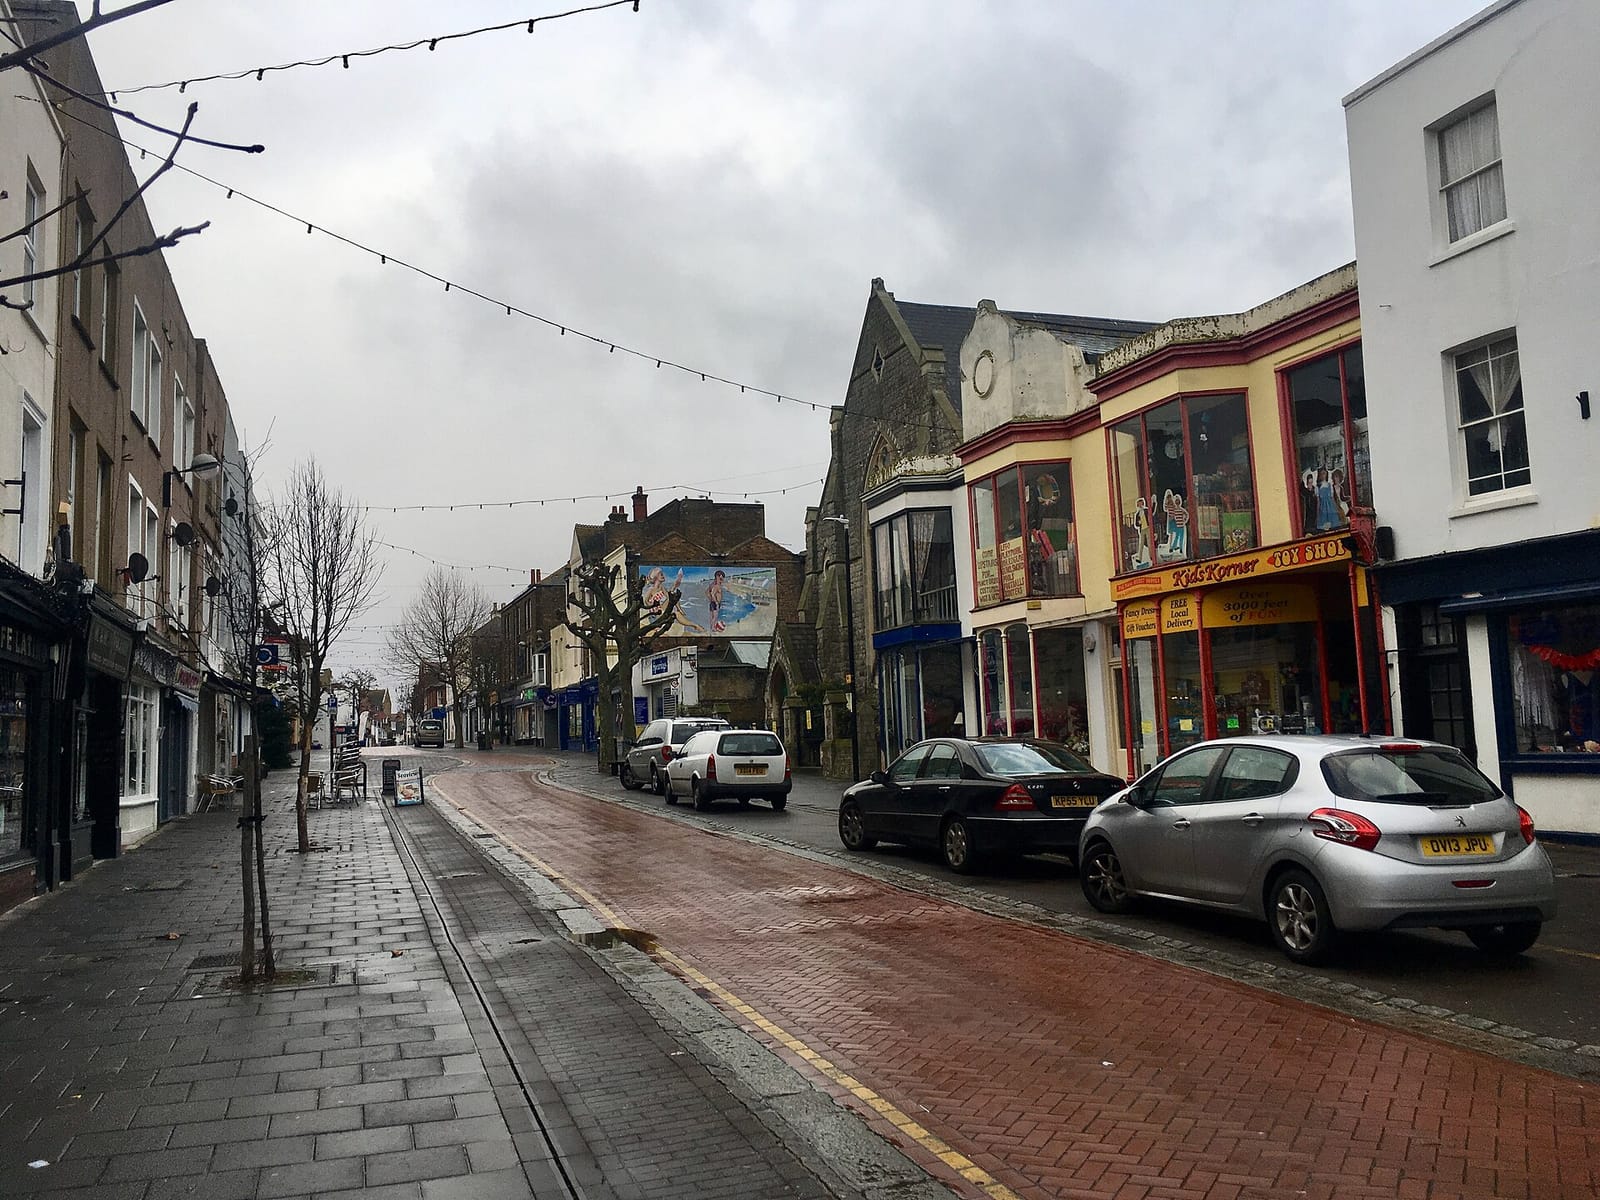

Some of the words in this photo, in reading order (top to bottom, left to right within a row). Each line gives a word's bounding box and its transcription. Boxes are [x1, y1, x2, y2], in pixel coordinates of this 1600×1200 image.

[1273, 550, 1299, 567] TOY
[1170, 598, 1188, 609] FREE
[1224, 601, 1258, 611] 3000
[1126, 609, 1139, 618] Fancy
[1170, 608, 1188, 618] Local
[1231, 611, 1246, 622] of
[1126, 624, 1135, 634] Gift
[1136, 621, 1156, 631] Vouchers
[1166, 618, 1193, 628] Delivery
[329, 697, 335, 706] P
[1465, 838, 1488, 852] JPU
